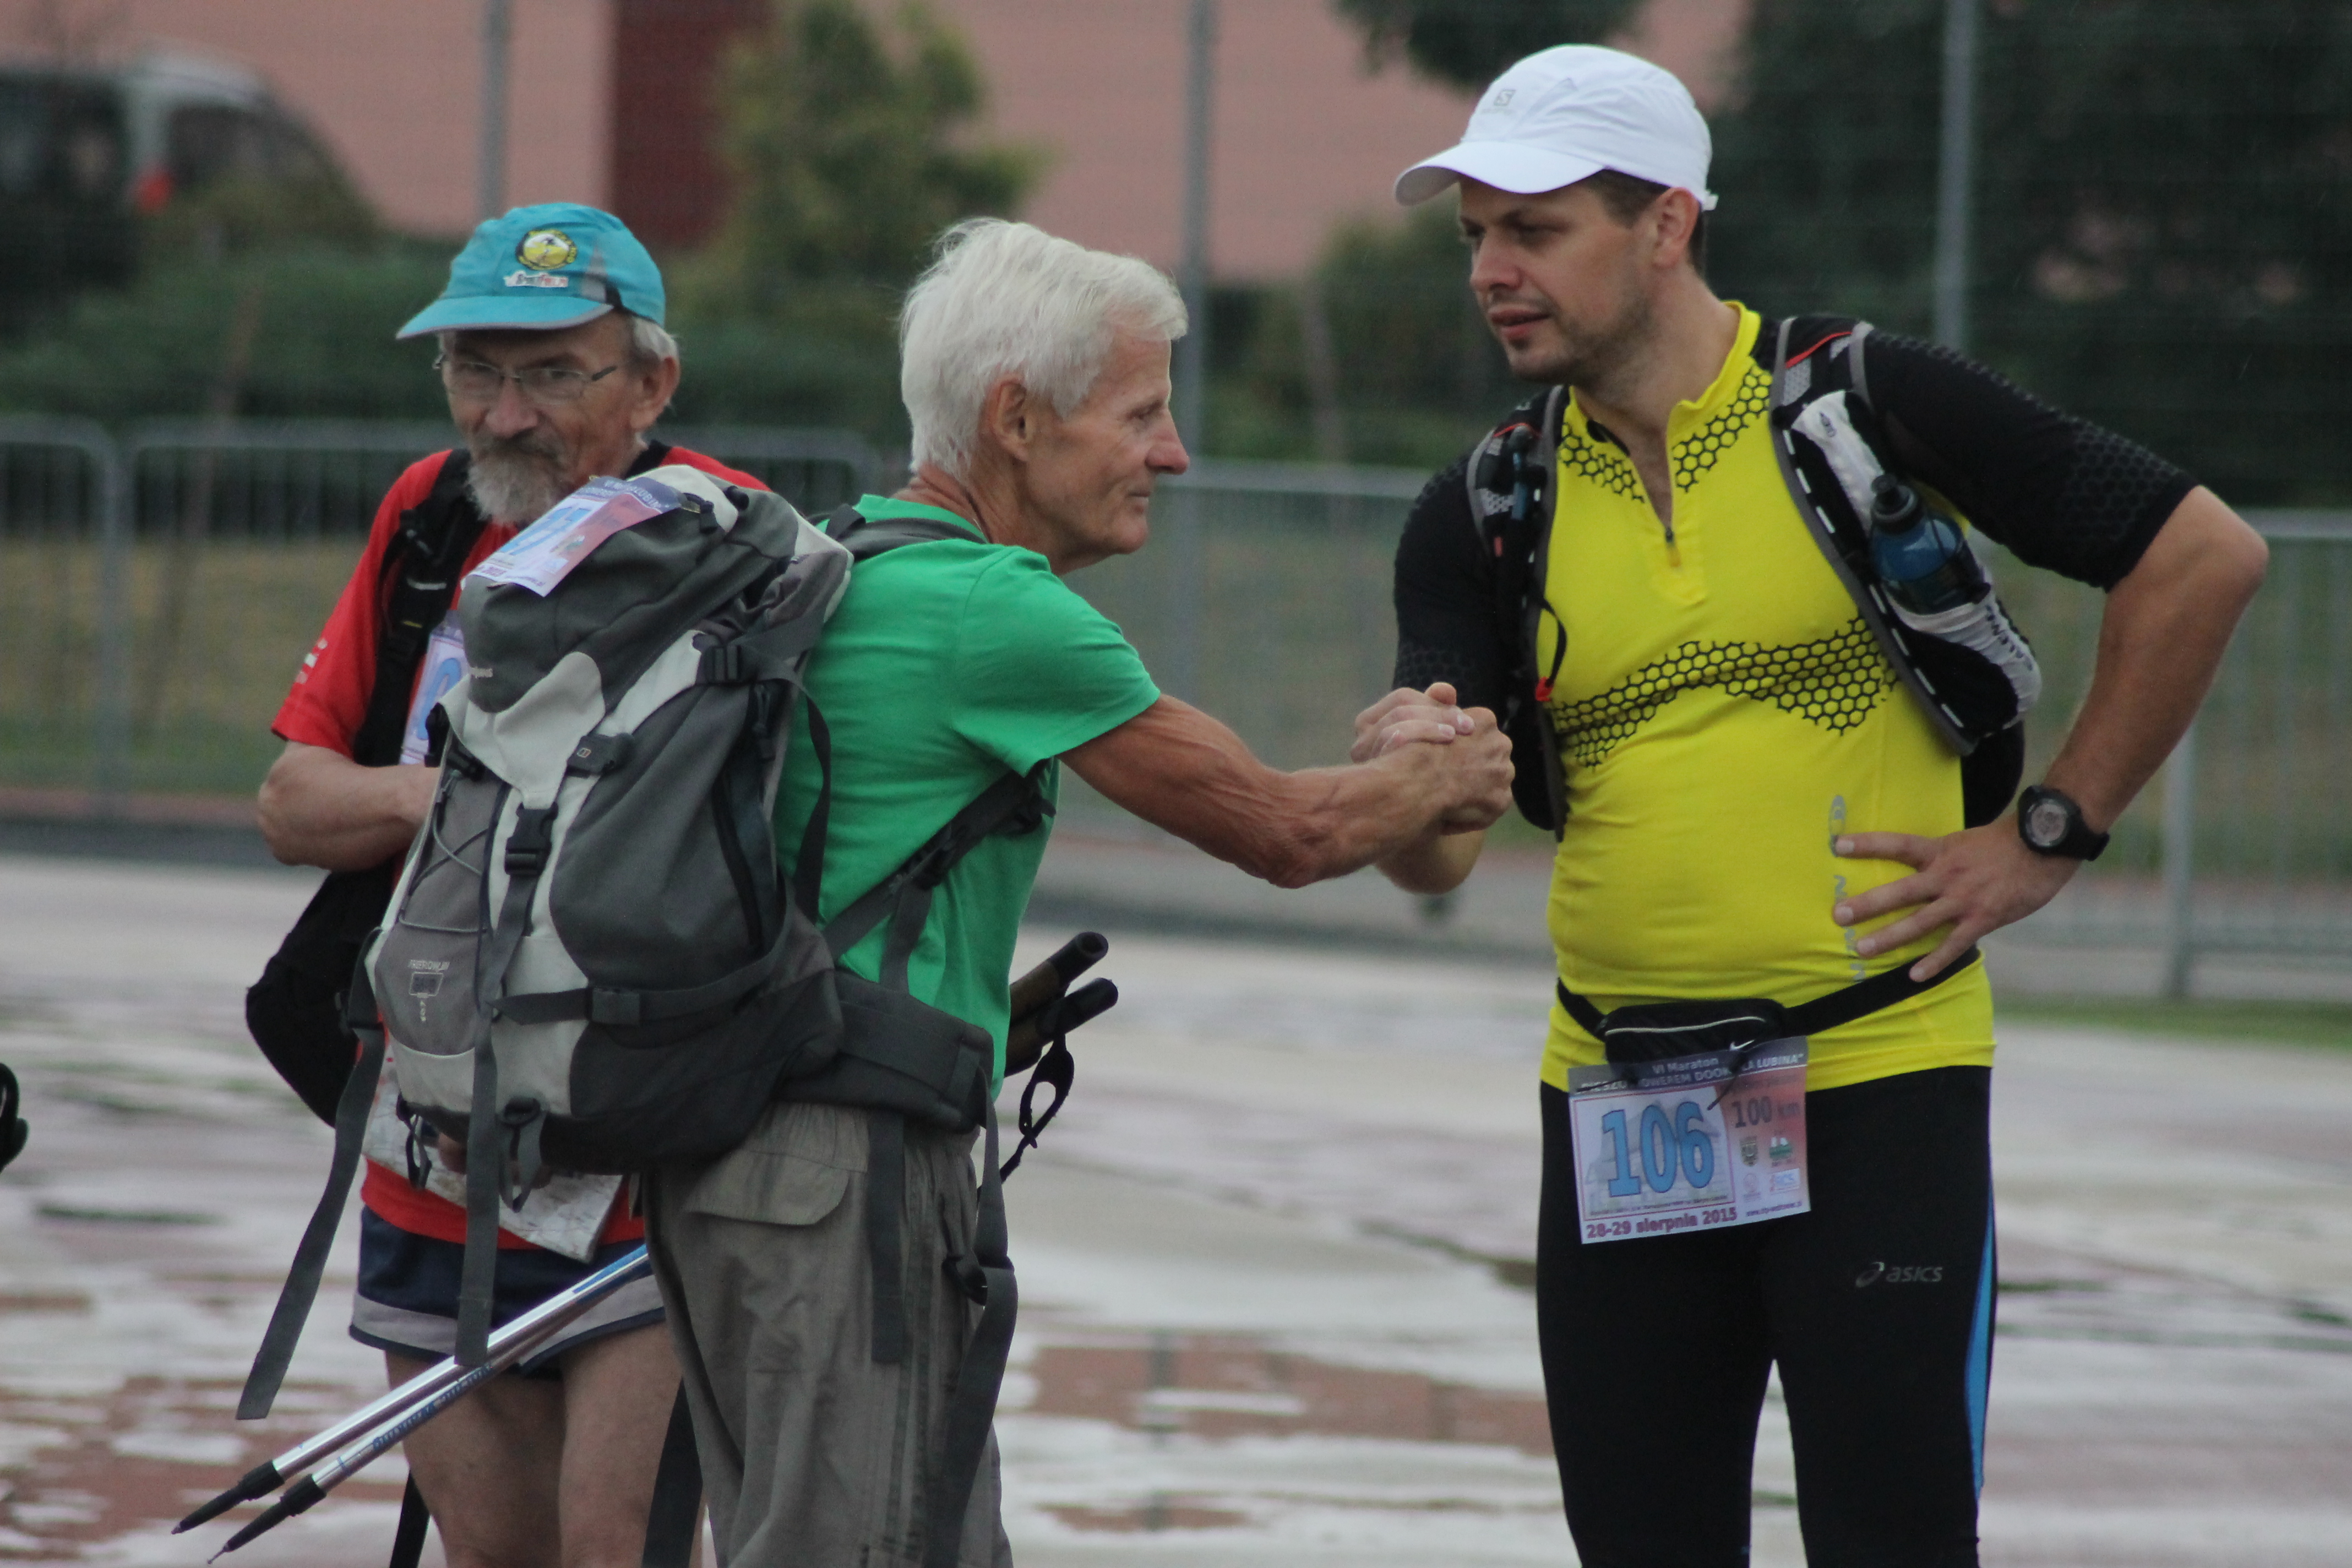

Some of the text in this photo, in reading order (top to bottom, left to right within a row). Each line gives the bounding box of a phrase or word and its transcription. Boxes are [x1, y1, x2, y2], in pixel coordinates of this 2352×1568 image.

[1667, 1057, 1719, 1073] Maraton
[1732, 1095, 1772, 1128] 100
[1602, 1101, 1715, 1198] 106
[1586, 1219, 1632, 1239] 28-29
[1636, 1212, 1698, 1233] sierpnia
[1702, 1206, 1738, 1226] 2015
[1885, 1266, 1943, 1283] asics
